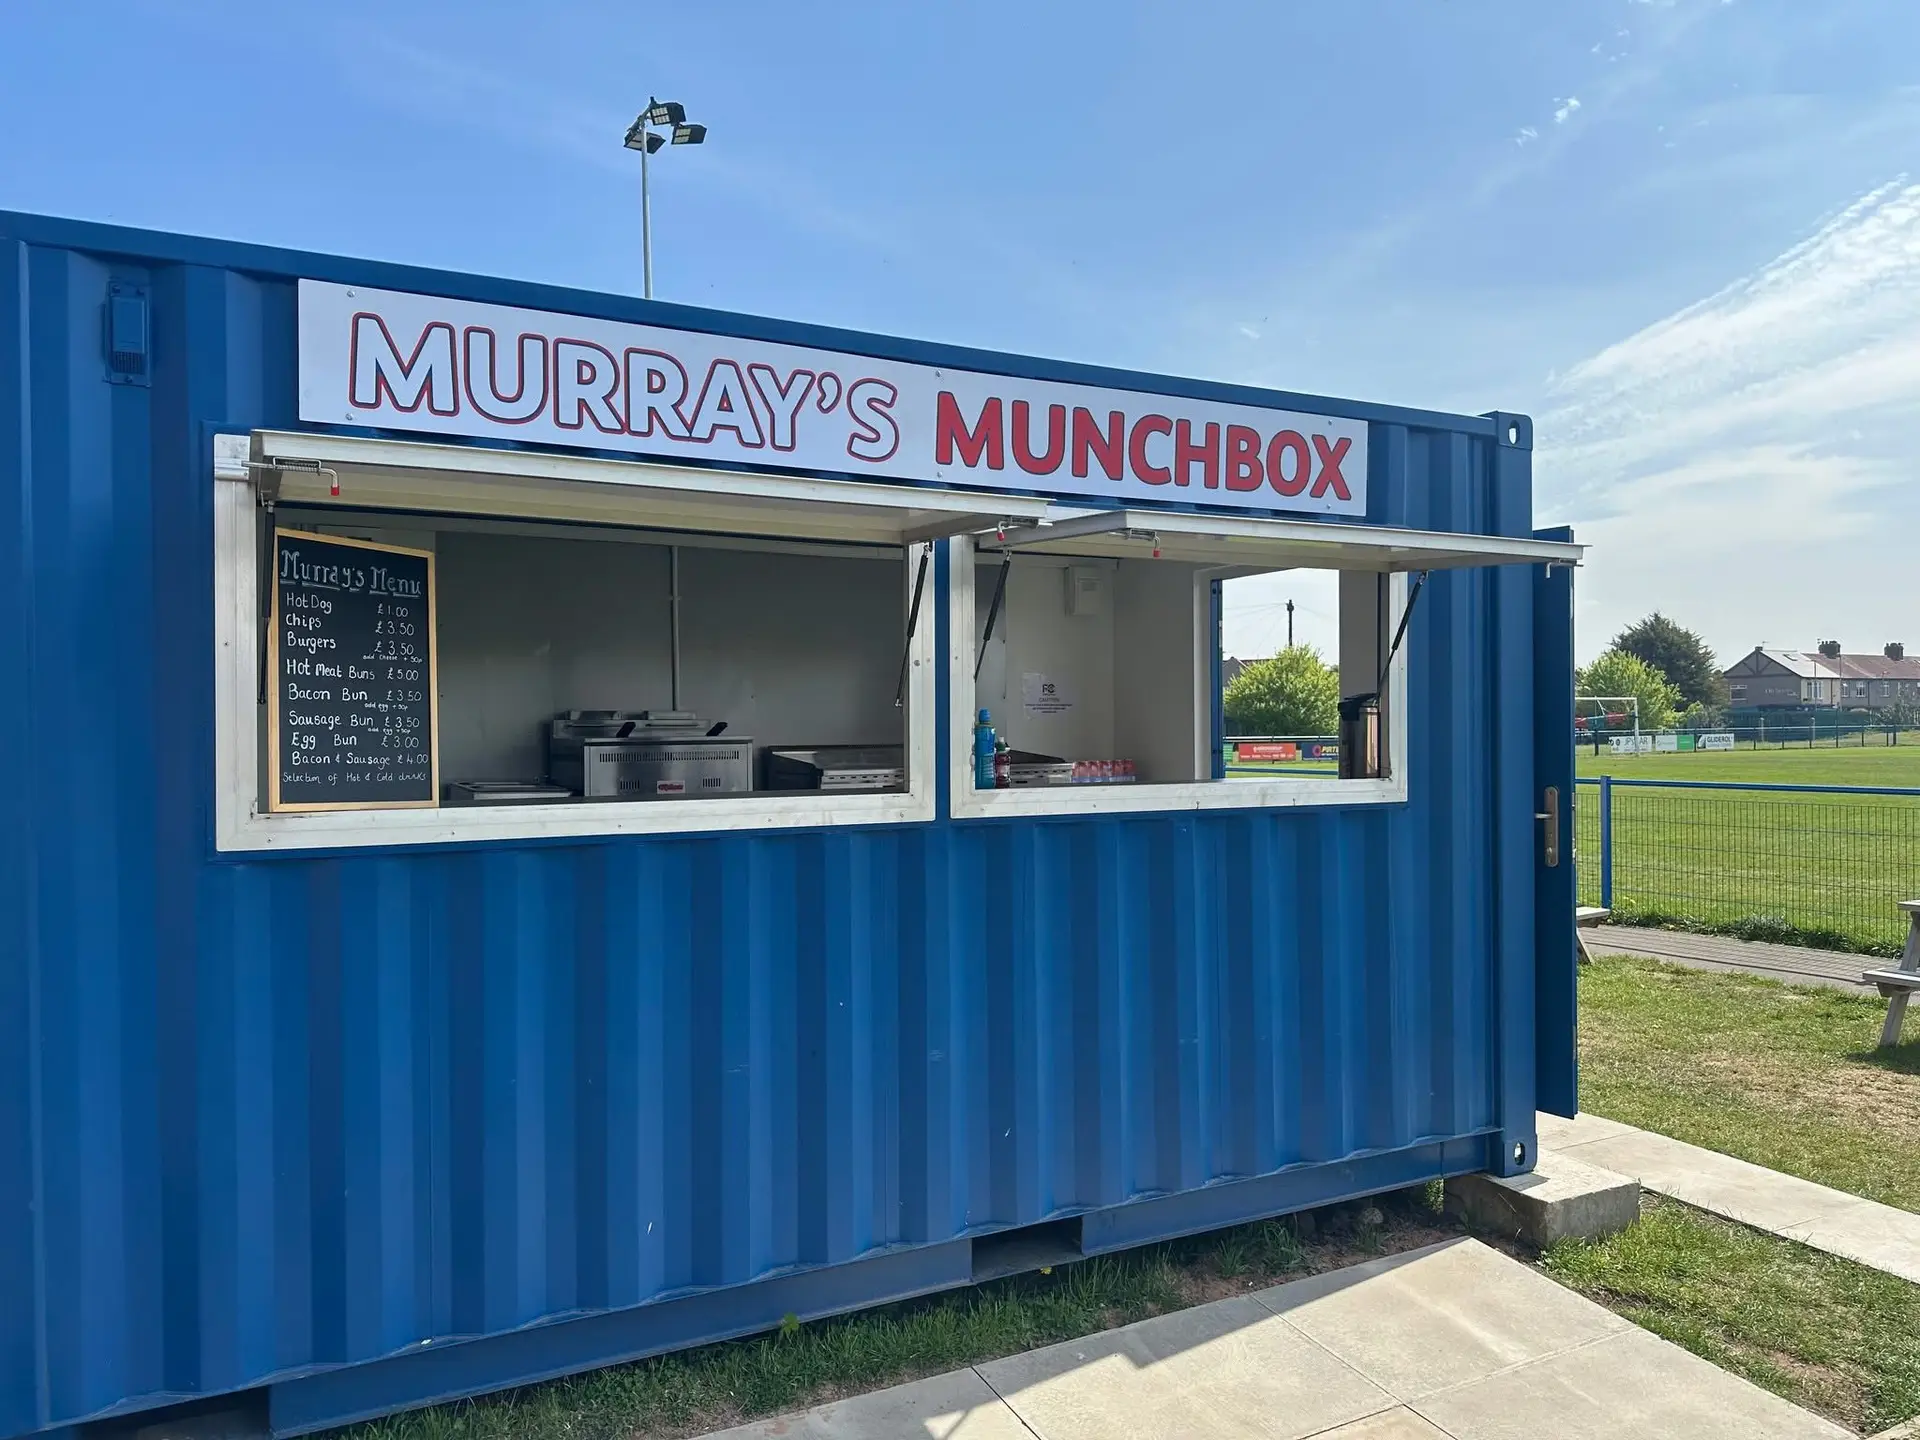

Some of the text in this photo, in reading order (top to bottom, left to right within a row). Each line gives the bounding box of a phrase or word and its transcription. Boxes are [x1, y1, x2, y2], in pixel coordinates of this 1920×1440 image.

[349, 311, 1353, 502] MURRAY'S MUNCHBOX
[280, 550, 421, 595] Murray's Menu
[286, 592, 309, 608] Hot
[311, 594, 332, 614] Dog
[285, 613, 322, 631] Chips
[287, 630, 337, 655] Burgers
[286, 658, 311, 676] Hot
[314, 662, 343, 678] Meat
[348, 665, 376, 681] Buns
[288, 682, 331, 701] Bacon
[341, 687, 368, 701] Bun
[288, 710, 342, 731] Sausage
[350, 713, 374, 728] Bun
[290, 731, 316, 750] Egg
[333, 733, 357, 746] Bun
[291, 750, 331, 766] Bacon
[346, 752, 391, 770] Sausage
[282, 771, 322, 784] Selection
[328, 773, 338, 786] of
[346, 773, 361, 782] Hot
[376, 772, 393, 782] Cold
[398, 772, 427, 782] drinks
